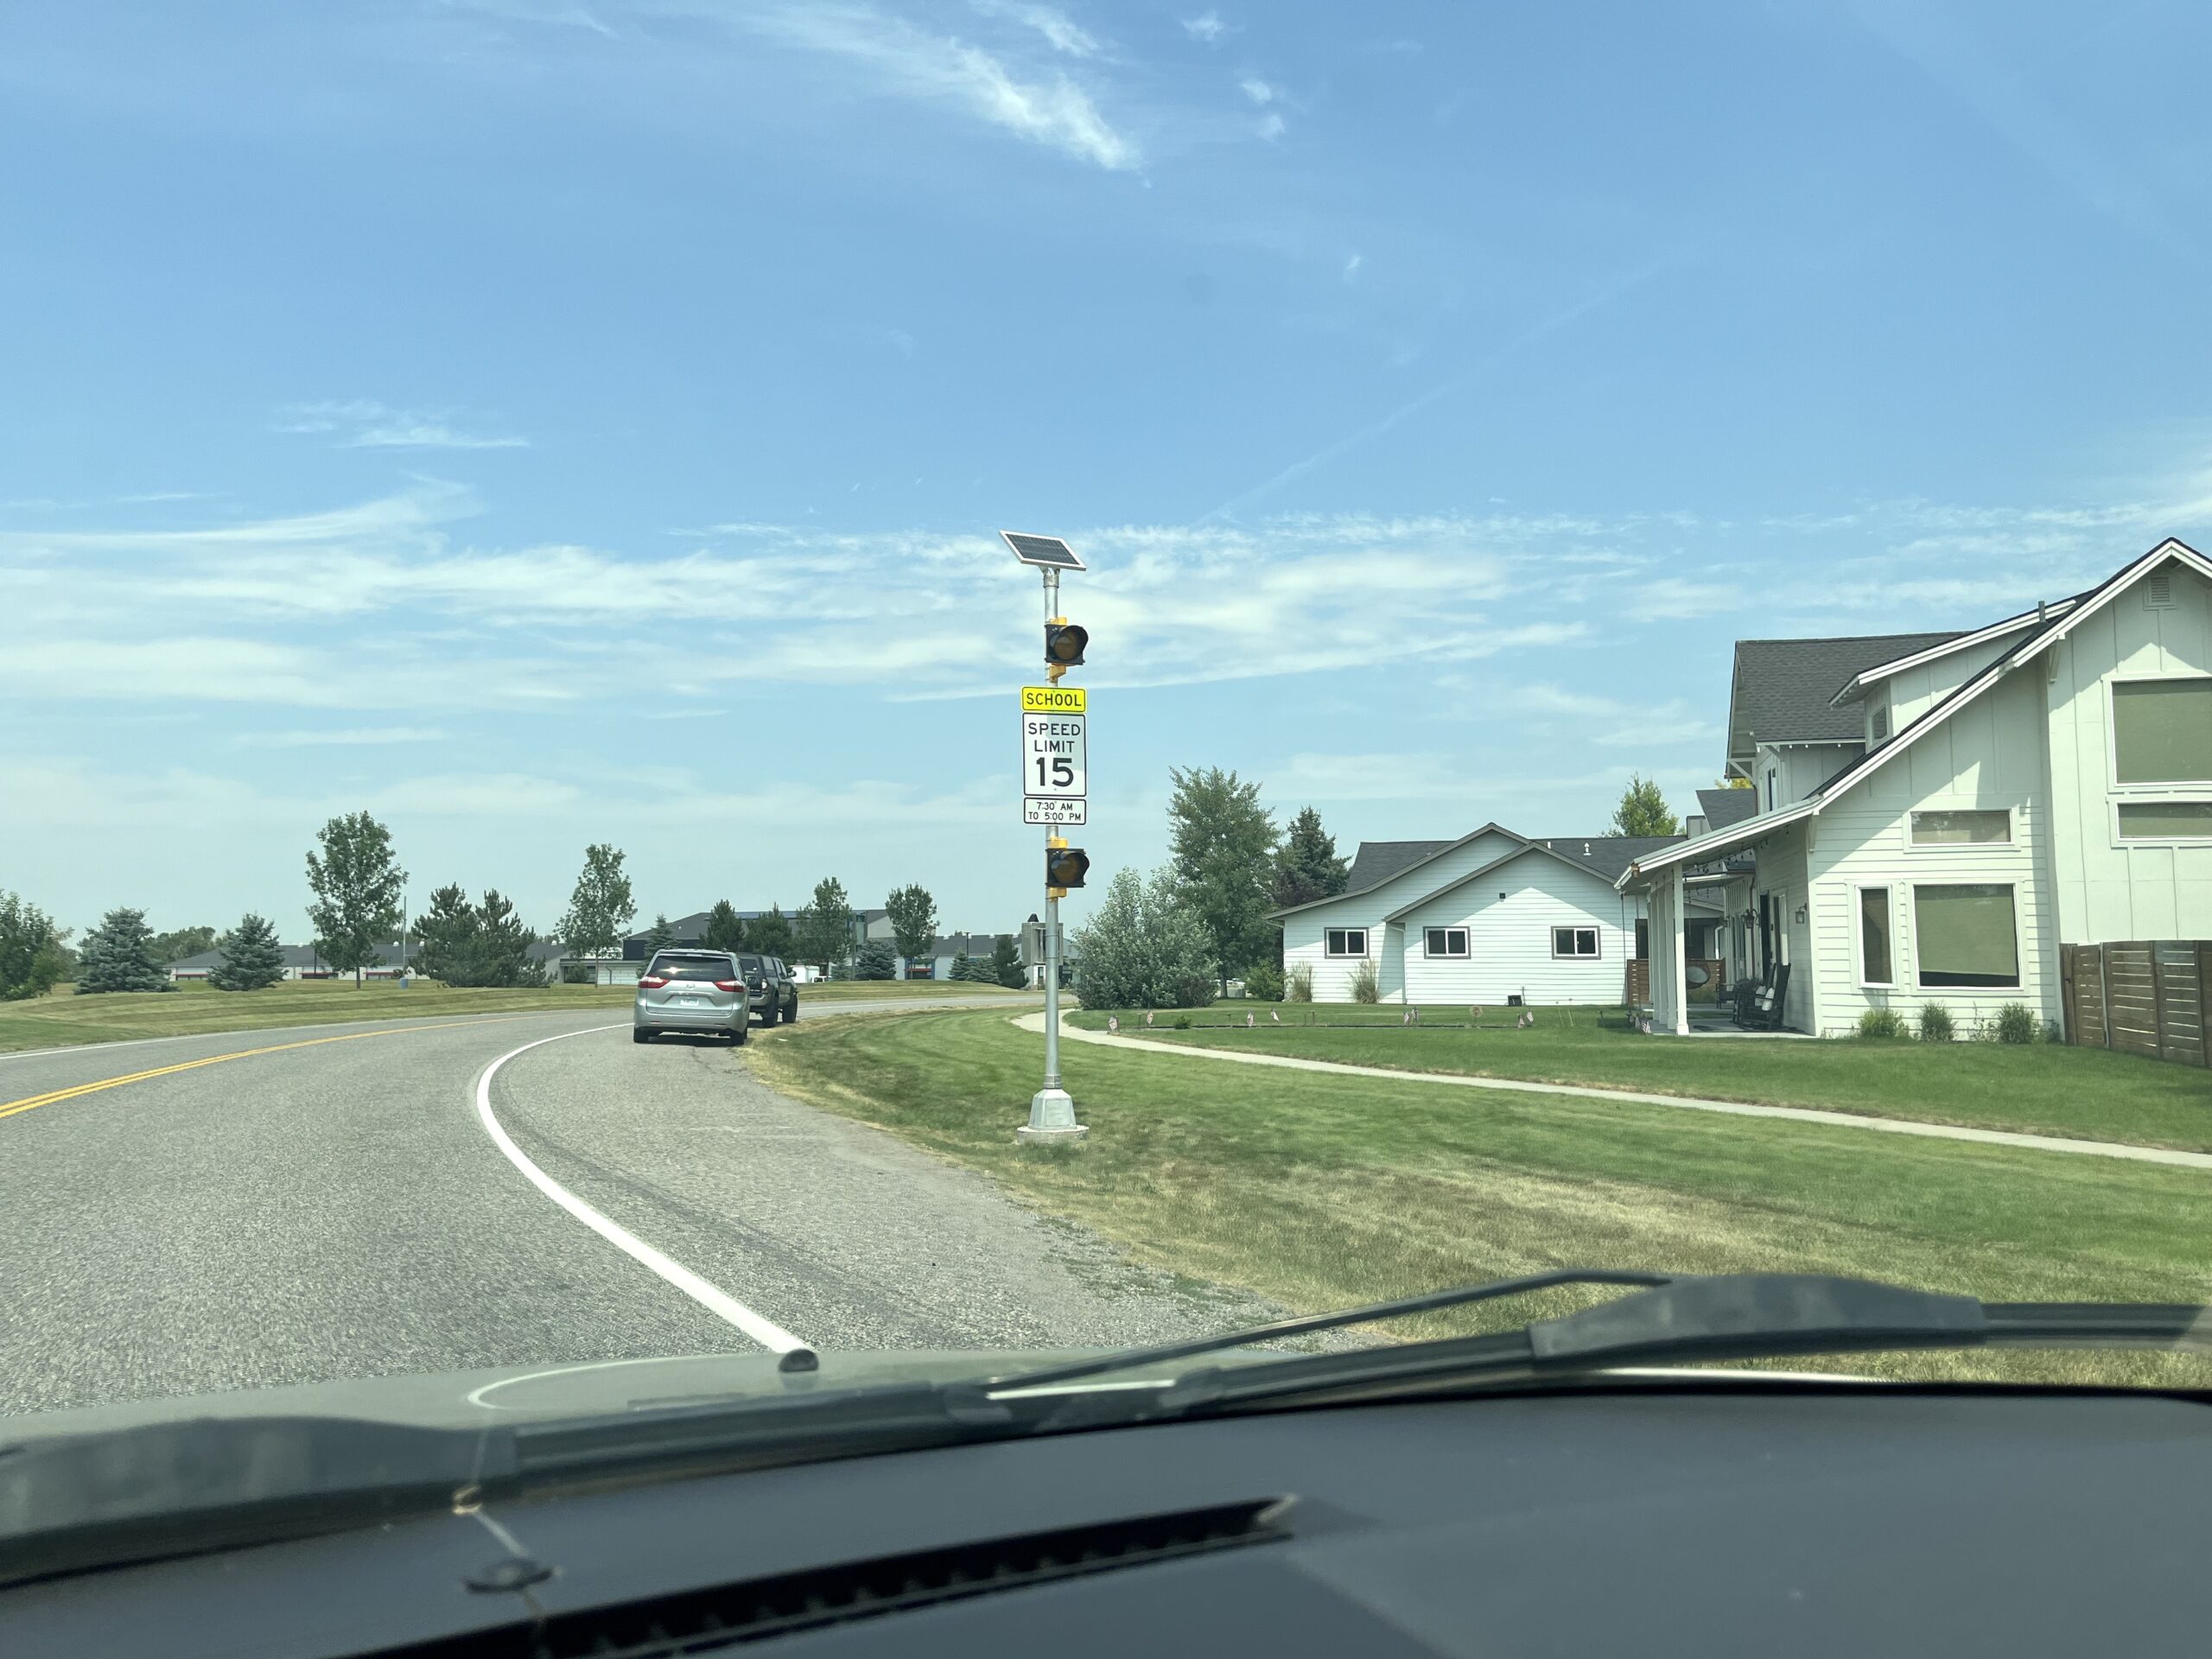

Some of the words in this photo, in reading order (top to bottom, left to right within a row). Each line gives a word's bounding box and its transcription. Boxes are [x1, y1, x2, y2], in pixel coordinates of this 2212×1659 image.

[1027, 693, 1082, 707] SCHOOL
[1028, 722, 1081, 736] SPEED
[1034, 740, 1075, 753] LIMIT
[1036, 757, 1074, 787] 15
[1037, 802, 1054, 810] 7:30
[1028, 811, 1039, 820] TO
[1045, 812, 1064, 821] 5:00
